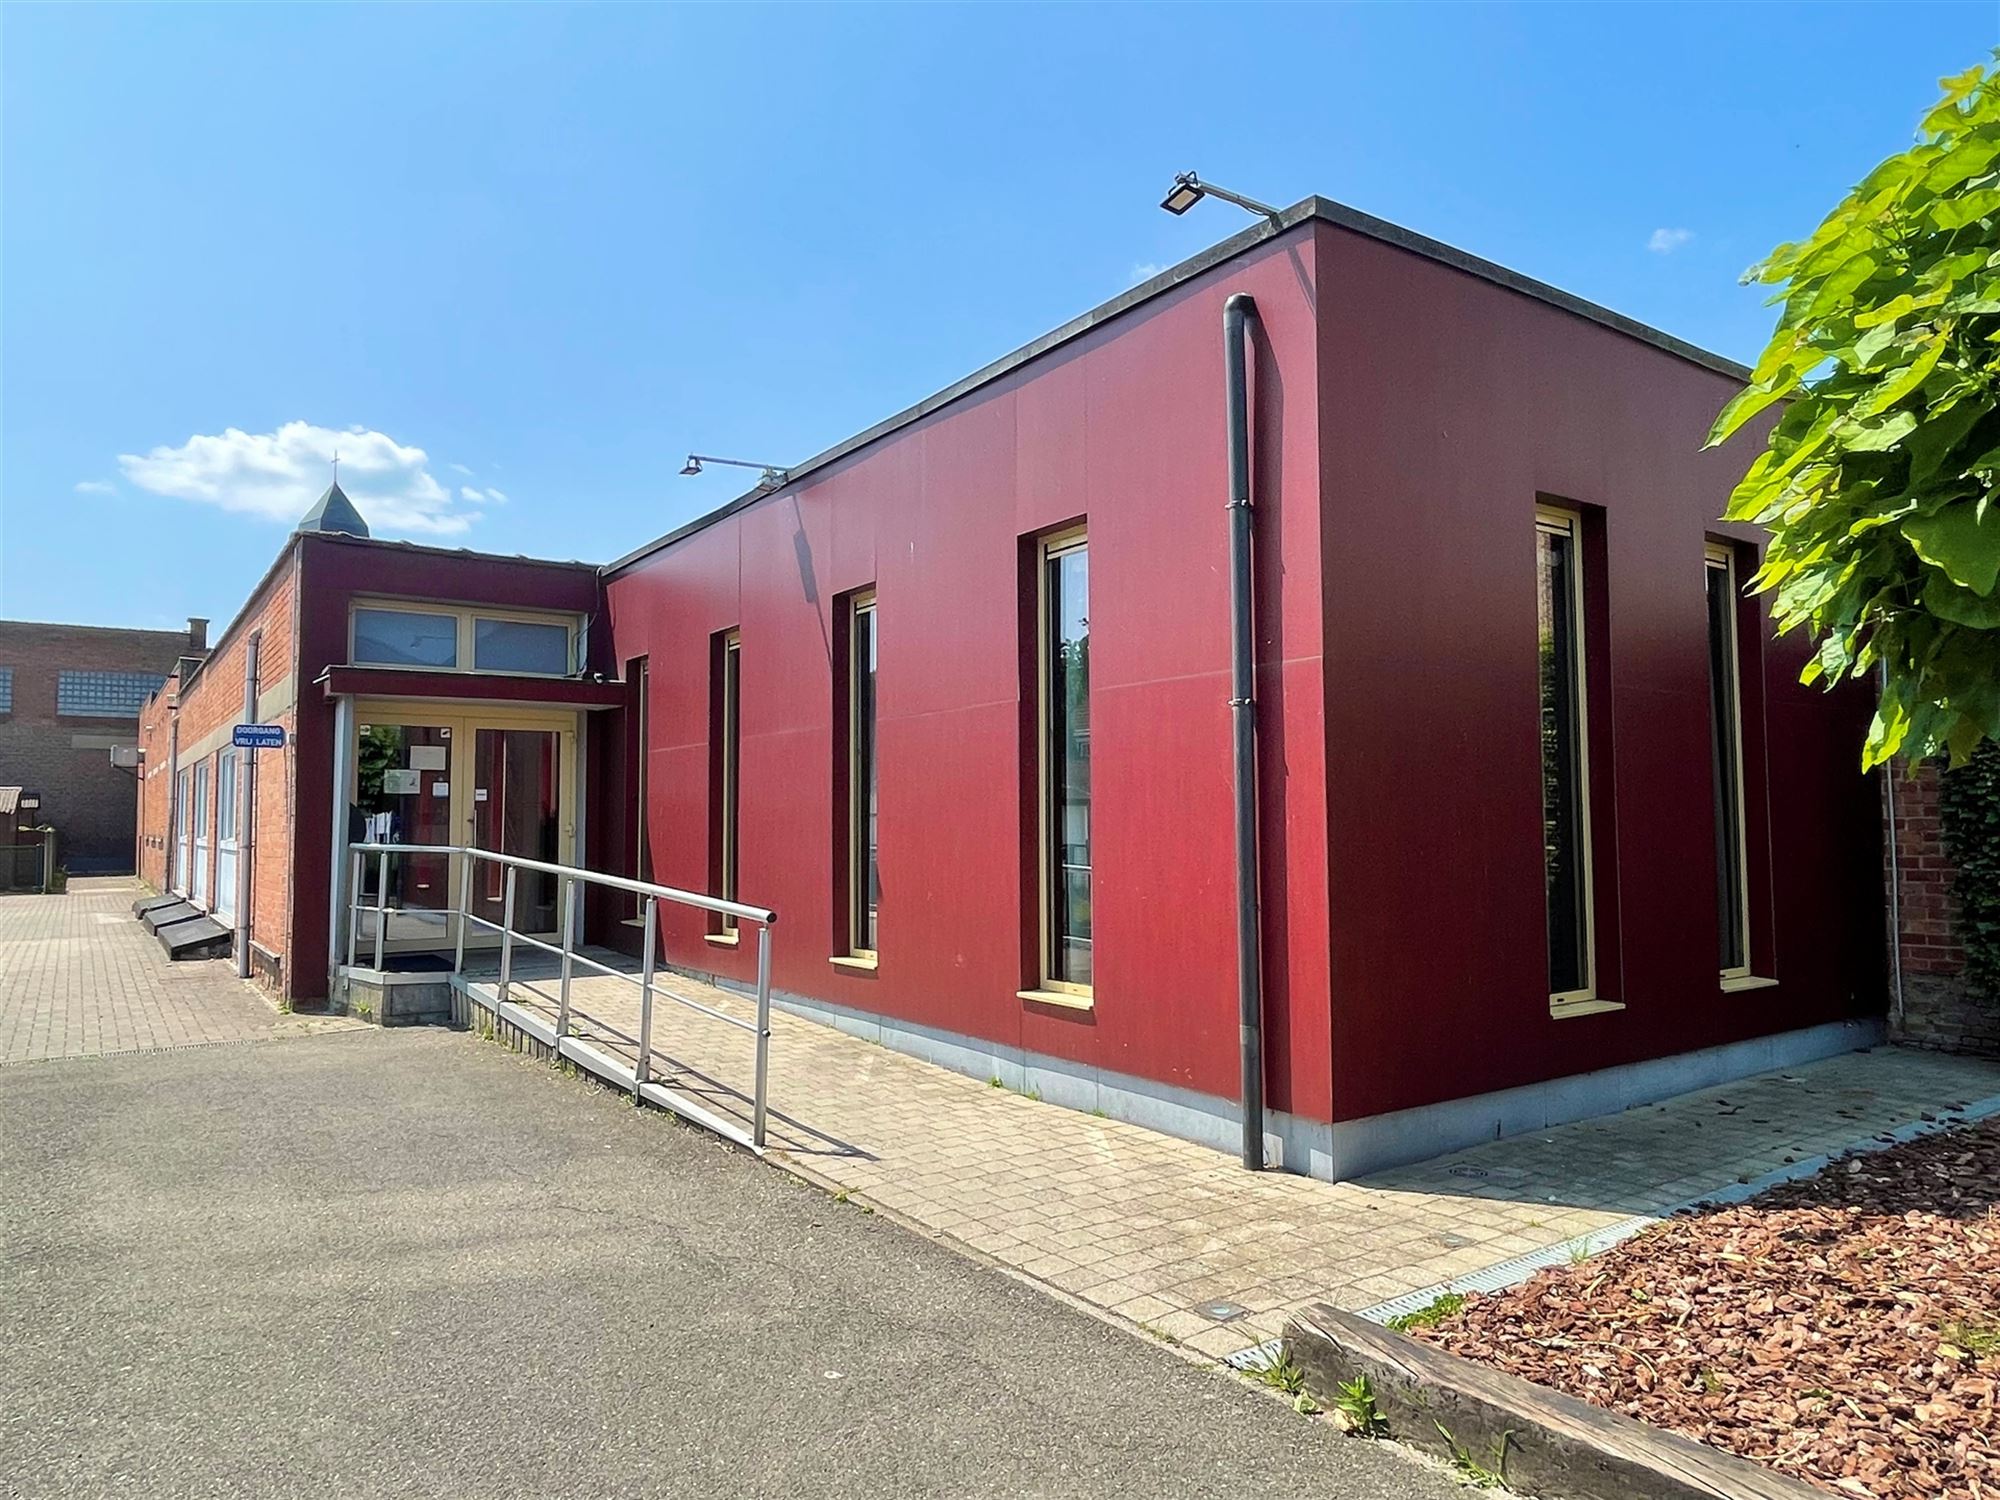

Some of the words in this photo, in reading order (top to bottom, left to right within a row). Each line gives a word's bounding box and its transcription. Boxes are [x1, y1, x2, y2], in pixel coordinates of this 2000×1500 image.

[236, 727, 281, 735] DOORGANG
[235, 737, 253, 745] VRIJ
[256, 738, 282, 746] LATEN
